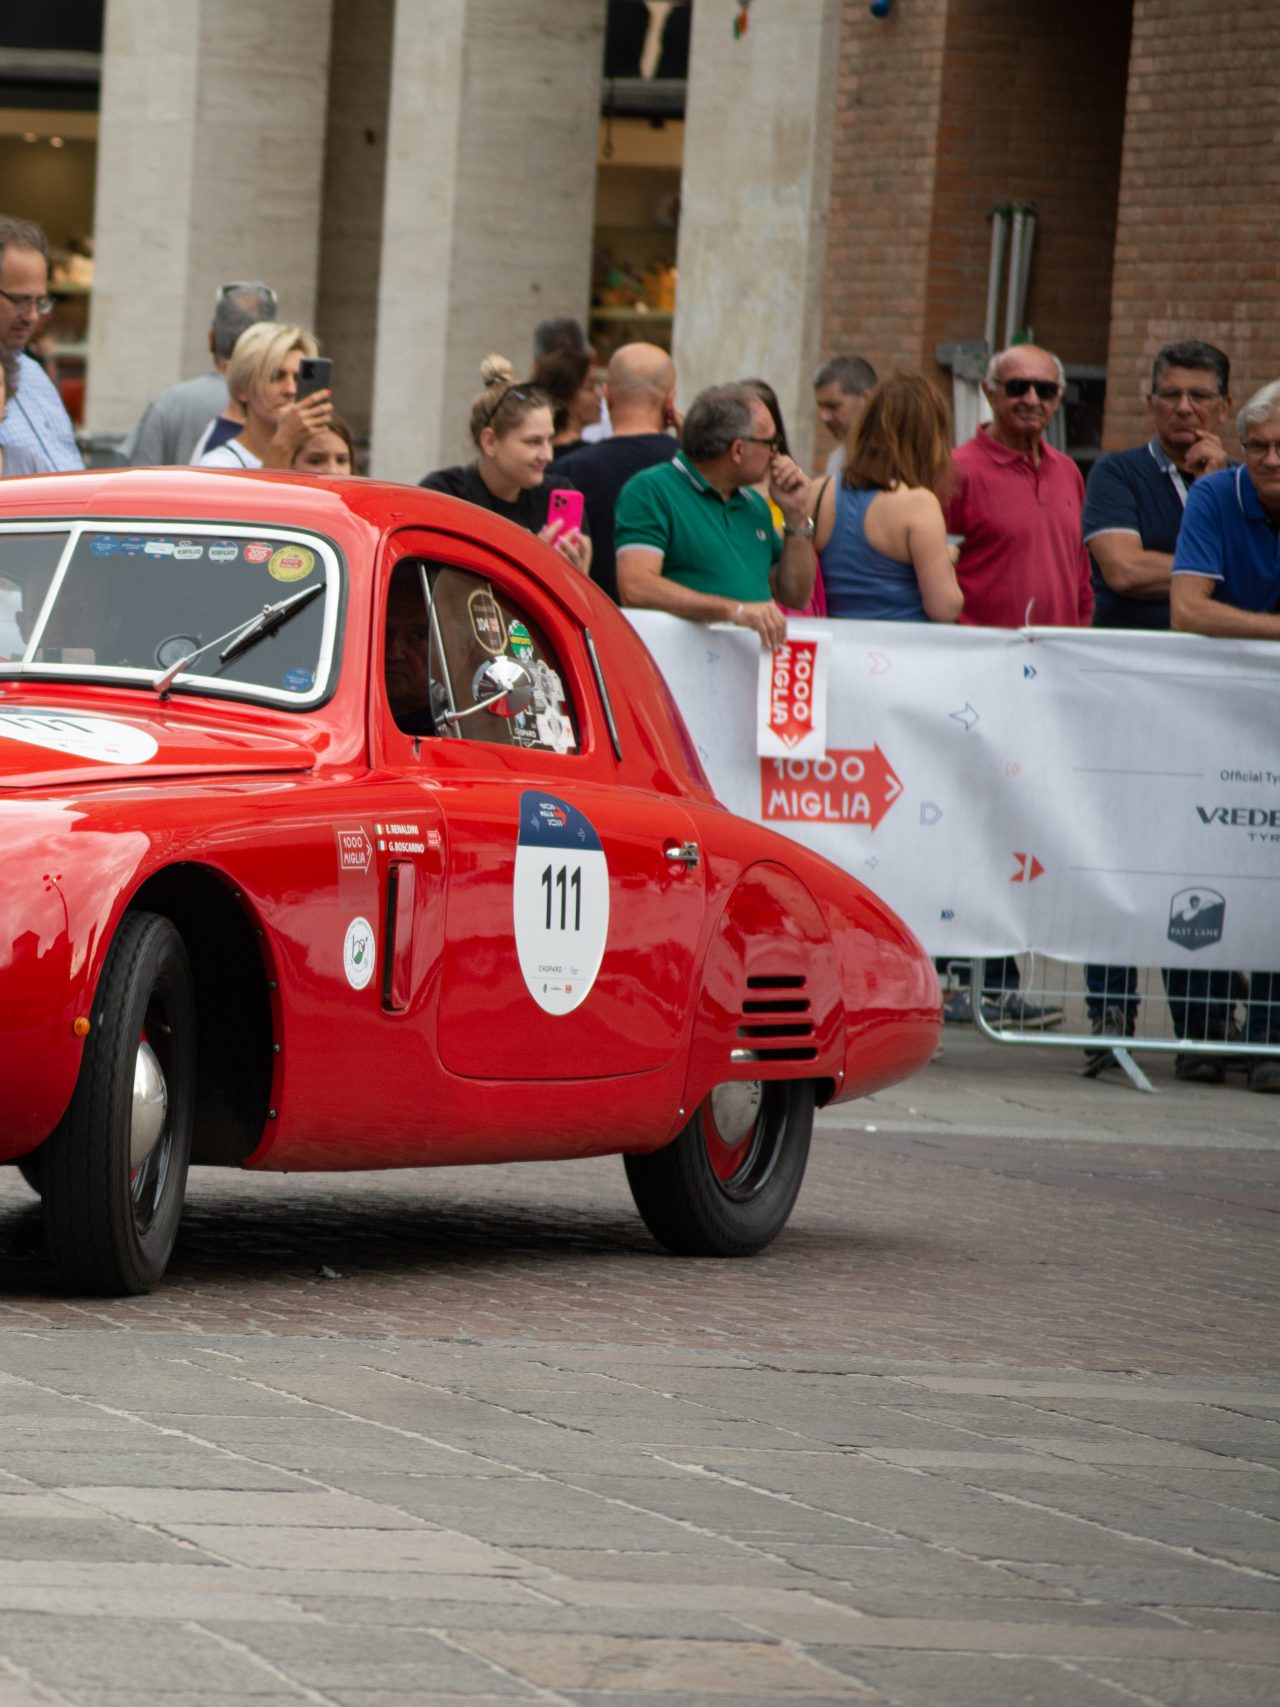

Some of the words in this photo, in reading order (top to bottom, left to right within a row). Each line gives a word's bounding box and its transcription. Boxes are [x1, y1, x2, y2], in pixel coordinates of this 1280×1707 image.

[773, 644, 791, 726] MIGLIA
[793, 650, 812, 721] 1000
[774, 757, 865, 783] 1000
[1220, 770, 1263, 782] Official
[768, 789, 870, 819] MIGLIA
[343, 836, 363, 848] 1000
[343, 852, 366, 864] MIGLIA
[541, 863, 581, 931] 111
[1171, 927, 1191, 935] FAST
[1194, 928, 1219, 937] LANE
